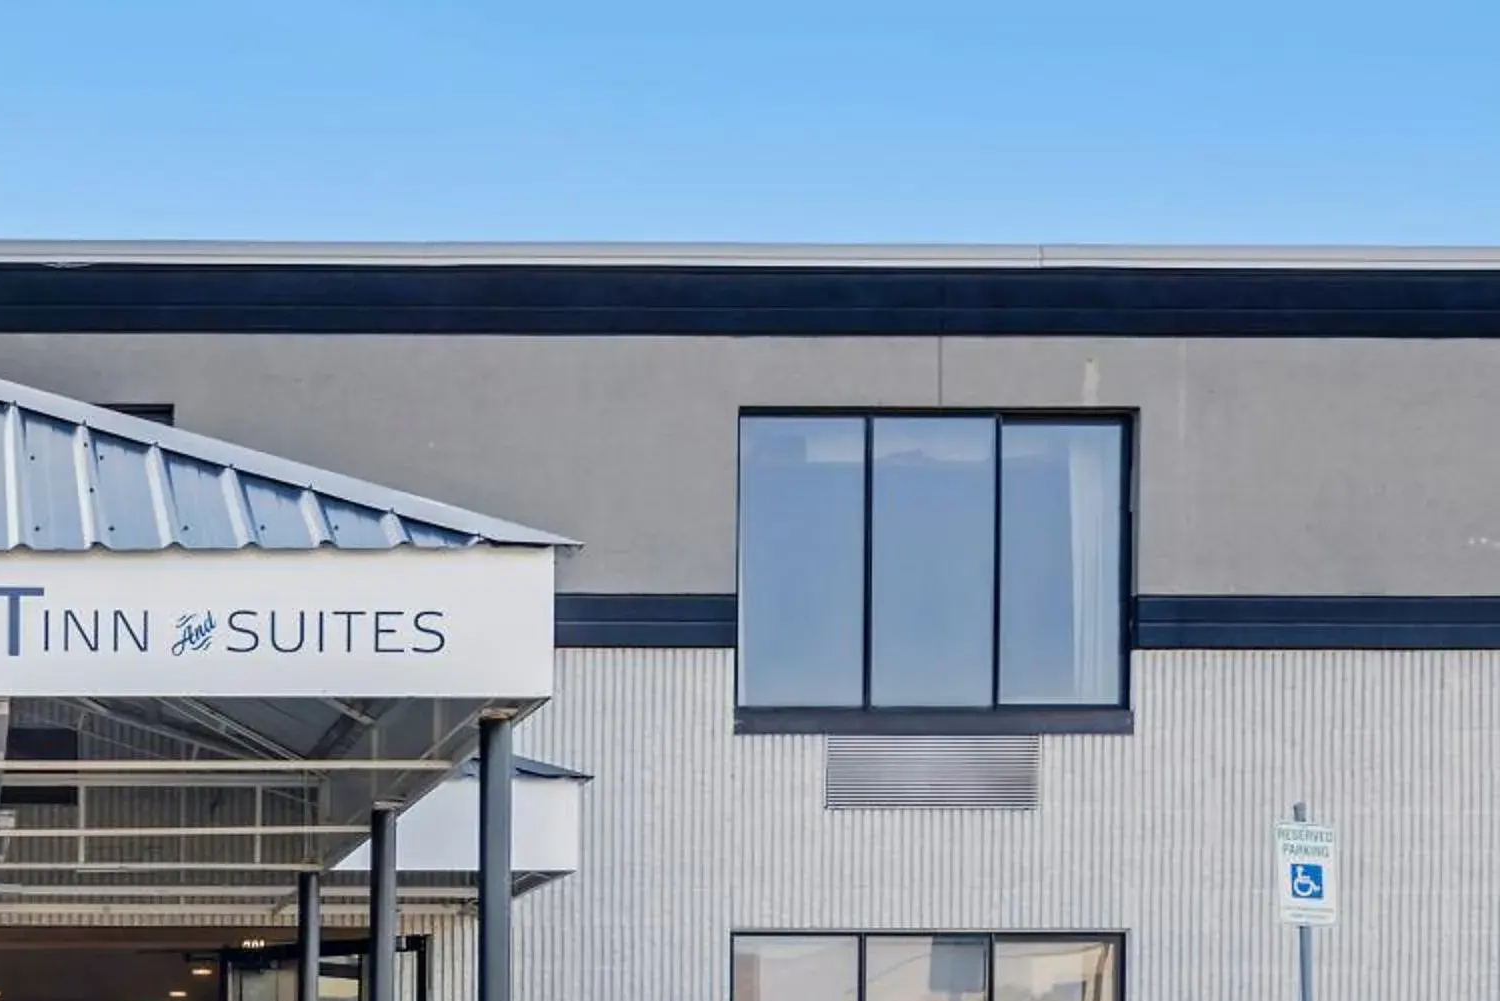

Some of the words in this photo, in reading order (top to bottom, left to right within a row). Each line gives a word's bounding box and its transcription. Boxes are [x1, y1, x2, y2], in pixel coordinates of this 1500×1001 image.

[43, 609, 149, 653] INN
[171, 609, 217, 657] And
[226, 609, 446, 654] SUITES
[1277, 827, 1333, 843] RESERVED
[1282, 842, 1330, 858] PARKING
